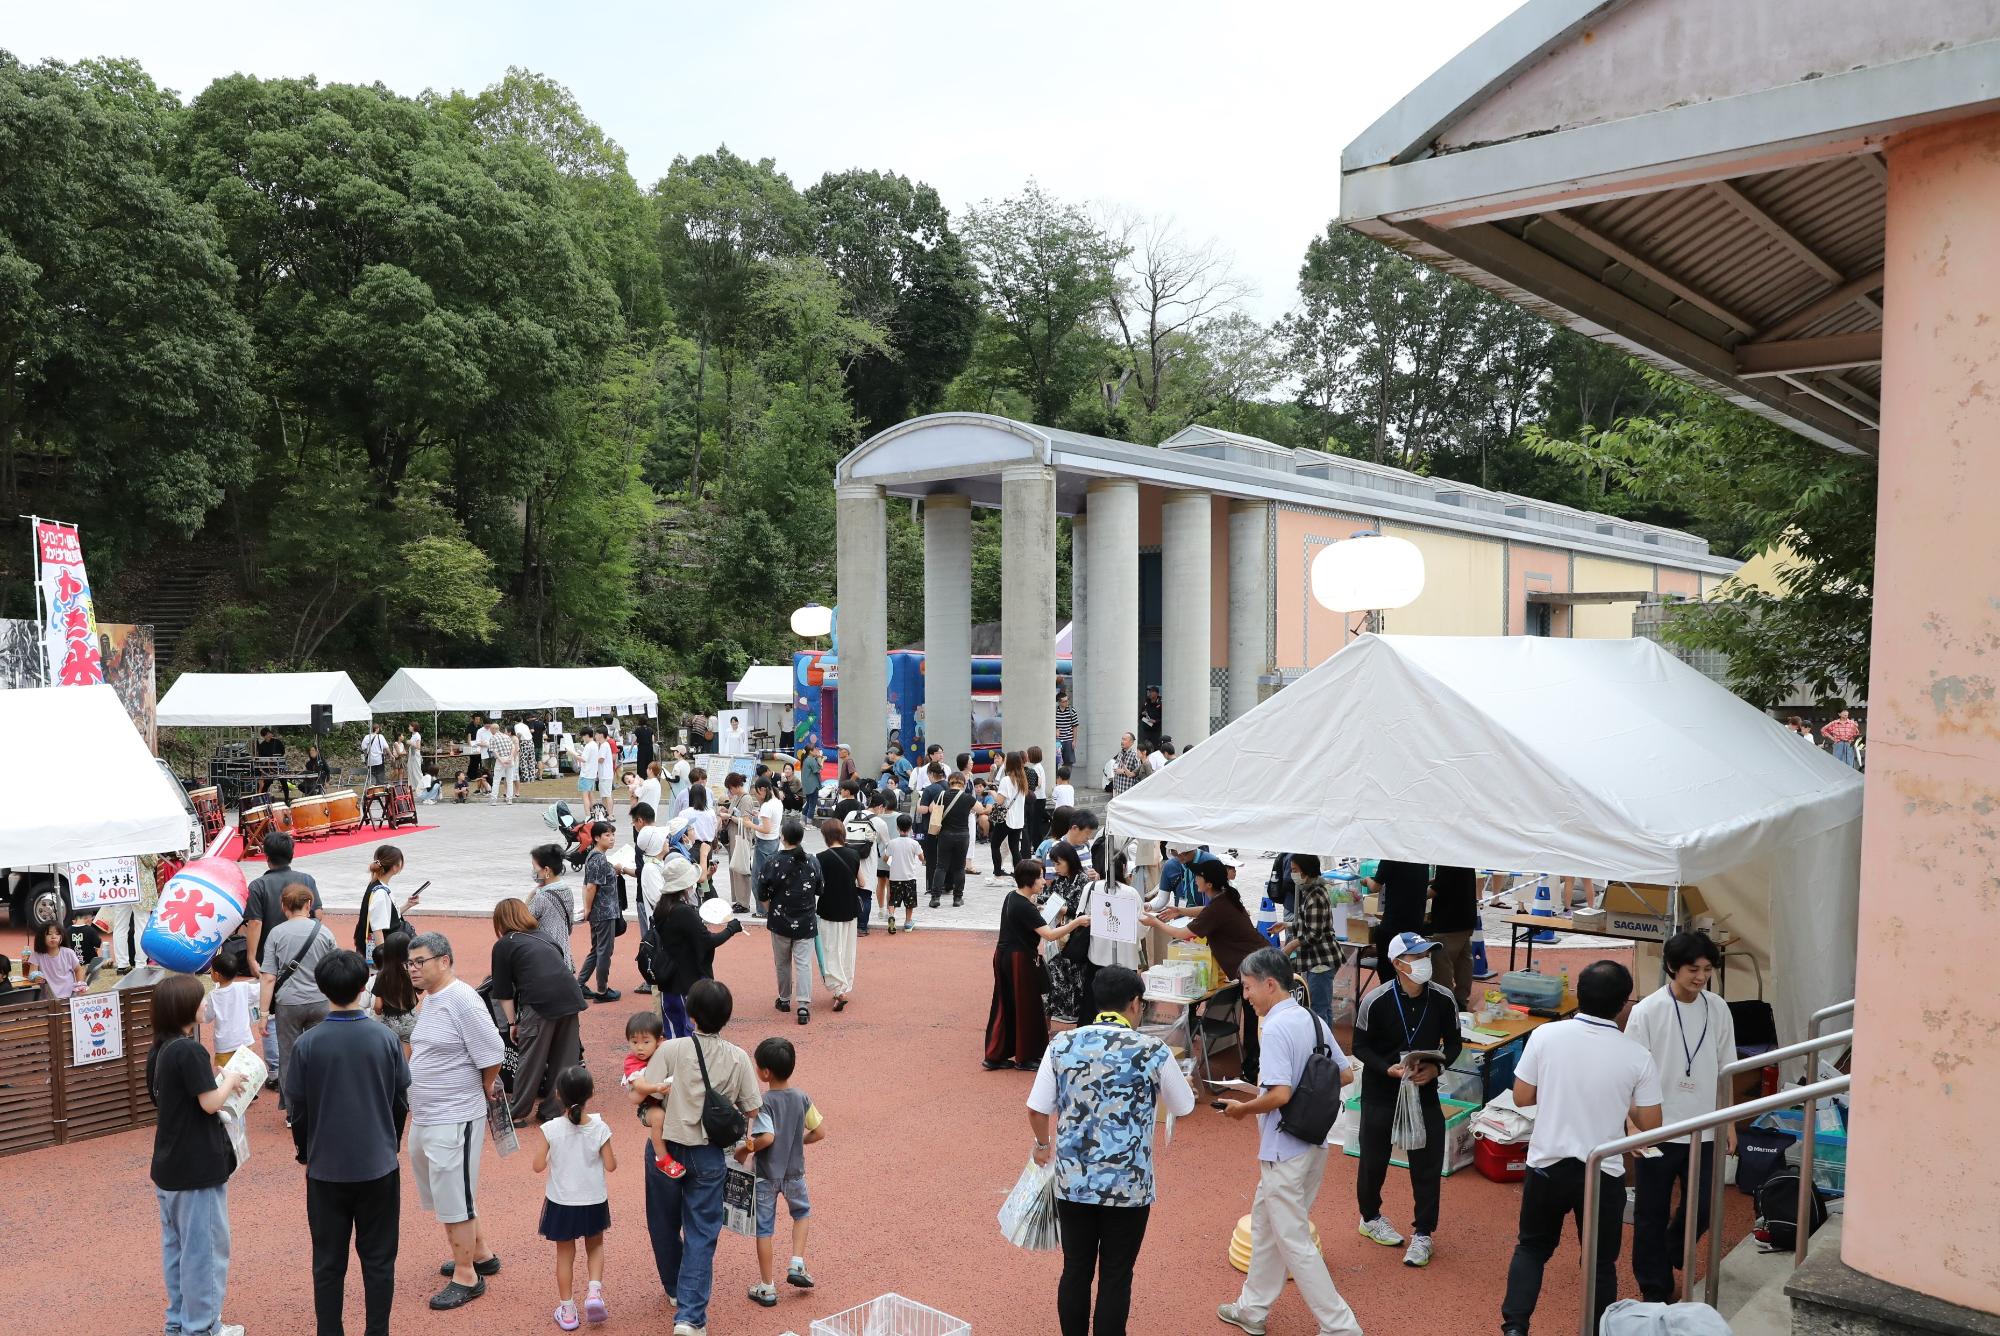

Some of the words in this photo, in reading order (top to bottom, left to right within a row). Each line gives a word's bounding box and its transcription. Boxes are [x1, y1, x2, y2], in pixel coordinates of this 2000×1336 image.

[99, 874, 134, 887] かき氷
[99, 886, 137, 900] 400円
[1613, 920, 1659, 933] SAGAWA
